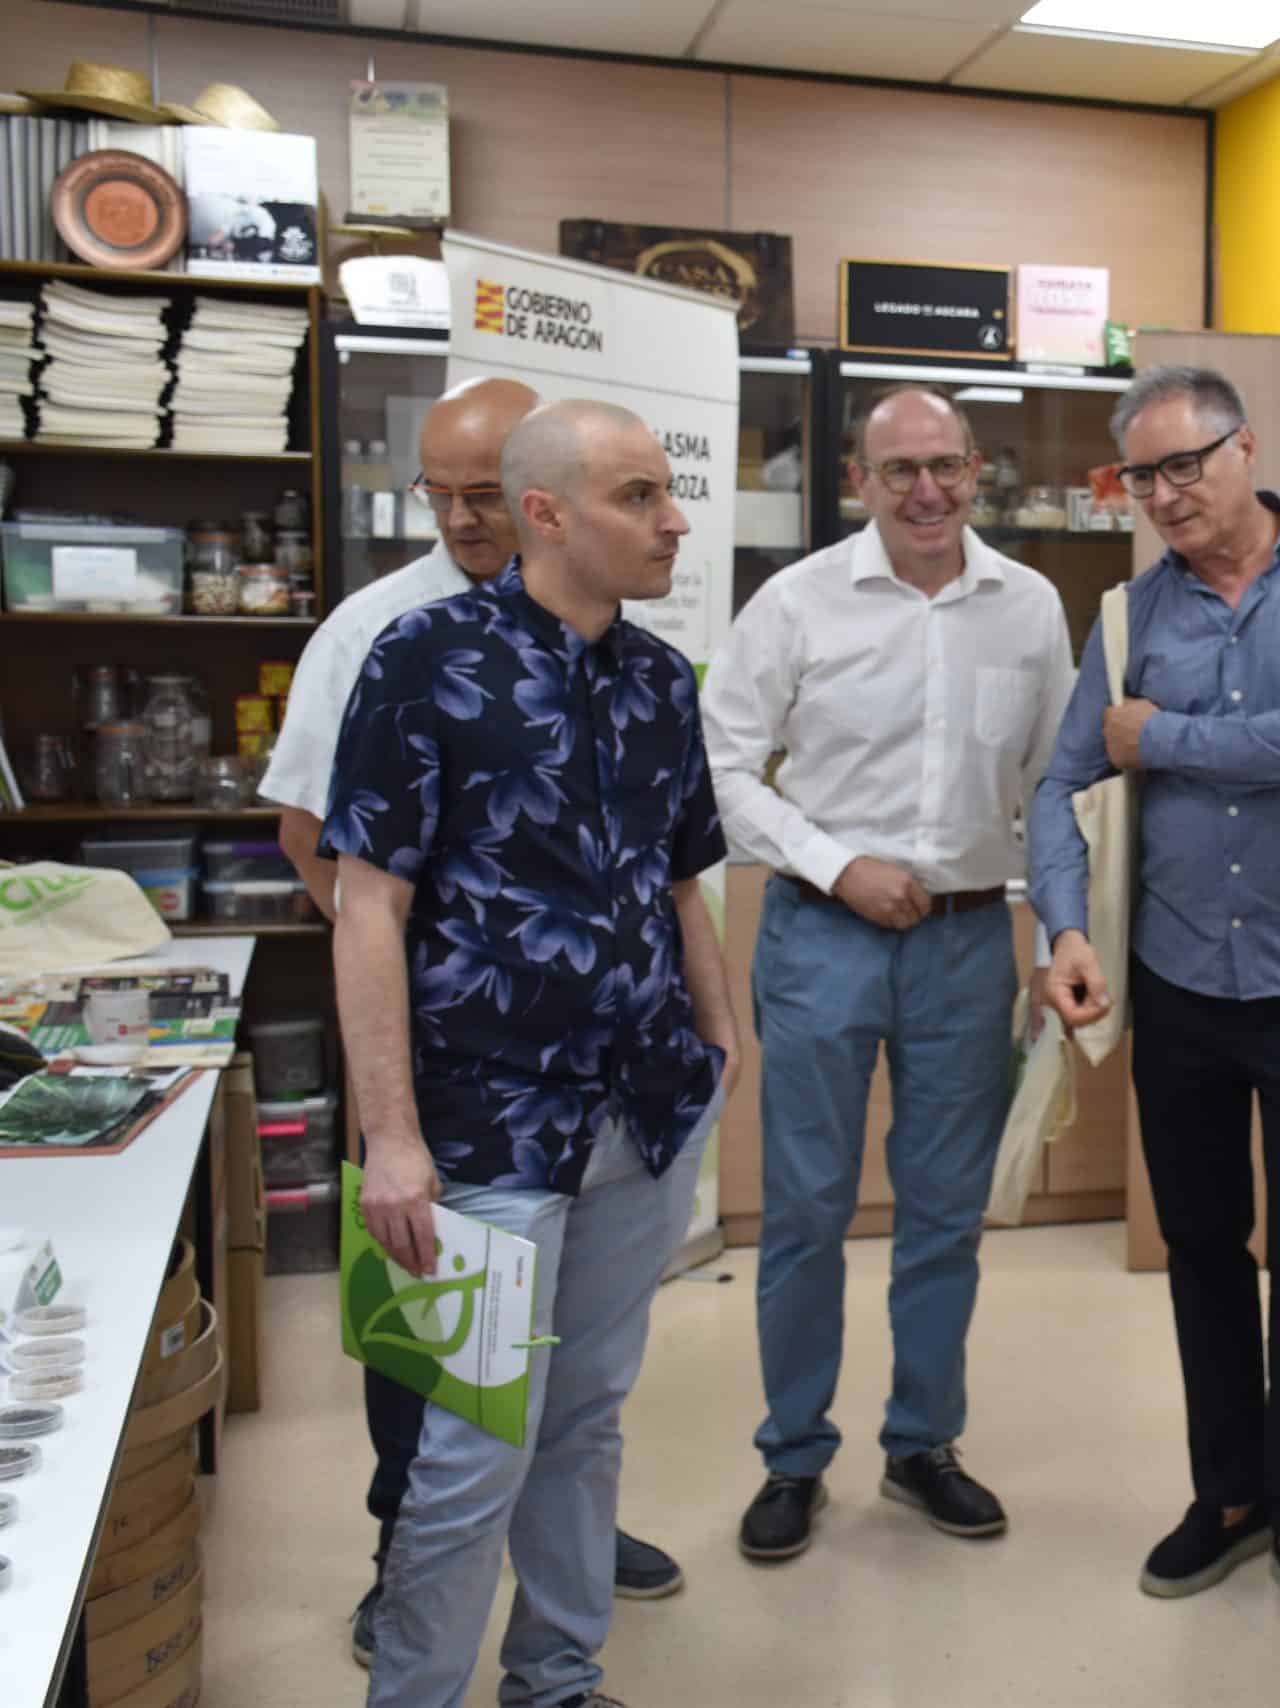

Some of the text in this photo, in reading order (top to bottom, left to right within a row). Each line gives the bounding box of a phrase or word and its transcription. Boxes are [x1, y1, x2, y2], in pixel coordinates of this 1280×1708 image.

[506, 287, 592, 325] GOBIERNO
[506, 313, 528, 340] DE
[665, 431, 711, 462] ASMA
